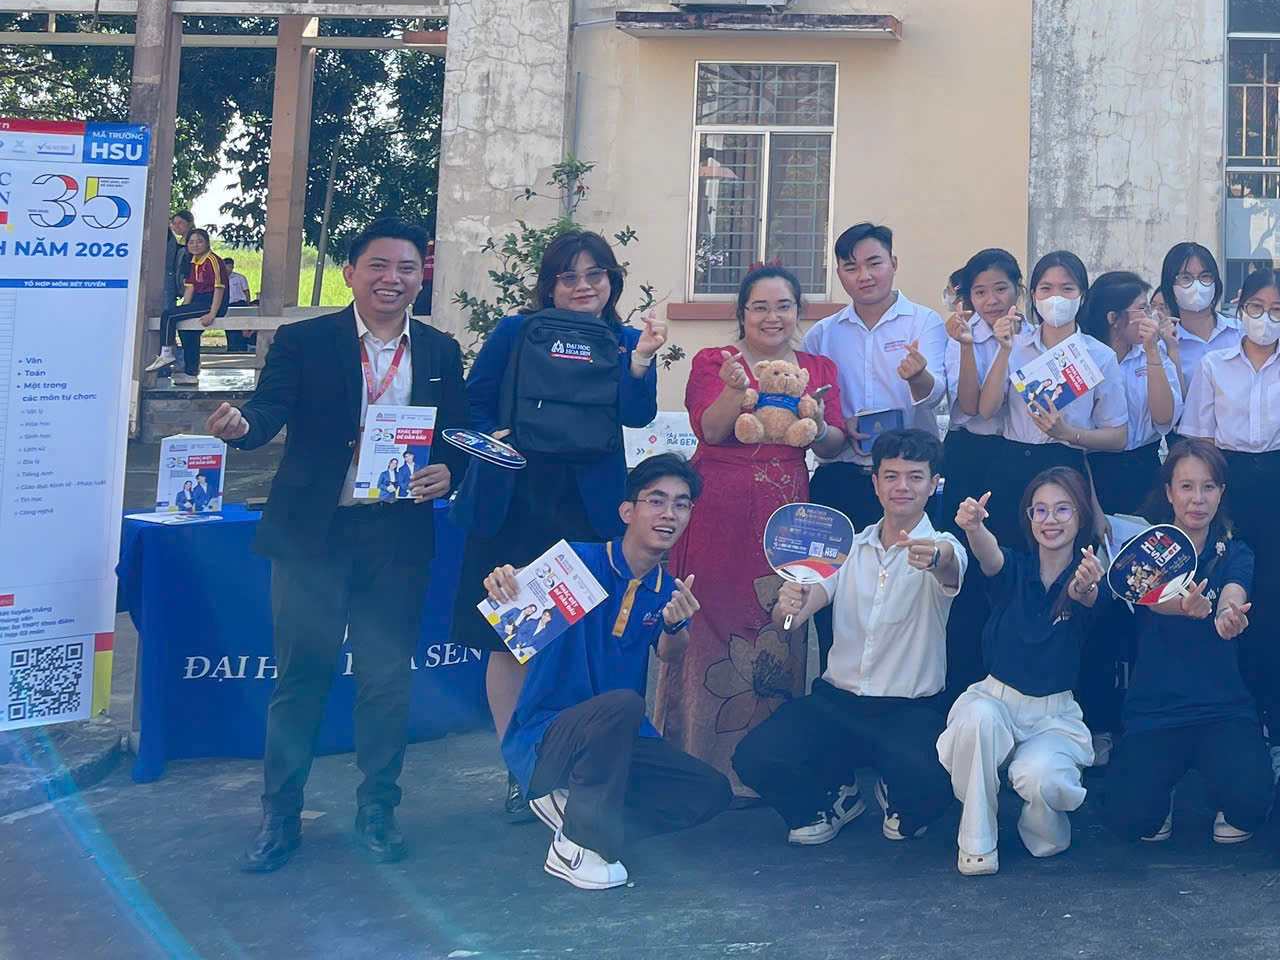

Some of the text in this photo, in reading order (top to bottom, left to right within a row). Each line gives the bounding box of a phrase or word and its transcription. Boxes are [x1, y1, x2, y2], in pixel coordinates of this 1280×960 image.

[91, 142, 142, 160] HSU
[28, 174, 132, 229] 35
[14, 237, 68, 256] NĂM
[75, 242, 129, 258] 2026
[183, 656, 250, 682] ĐẠI
